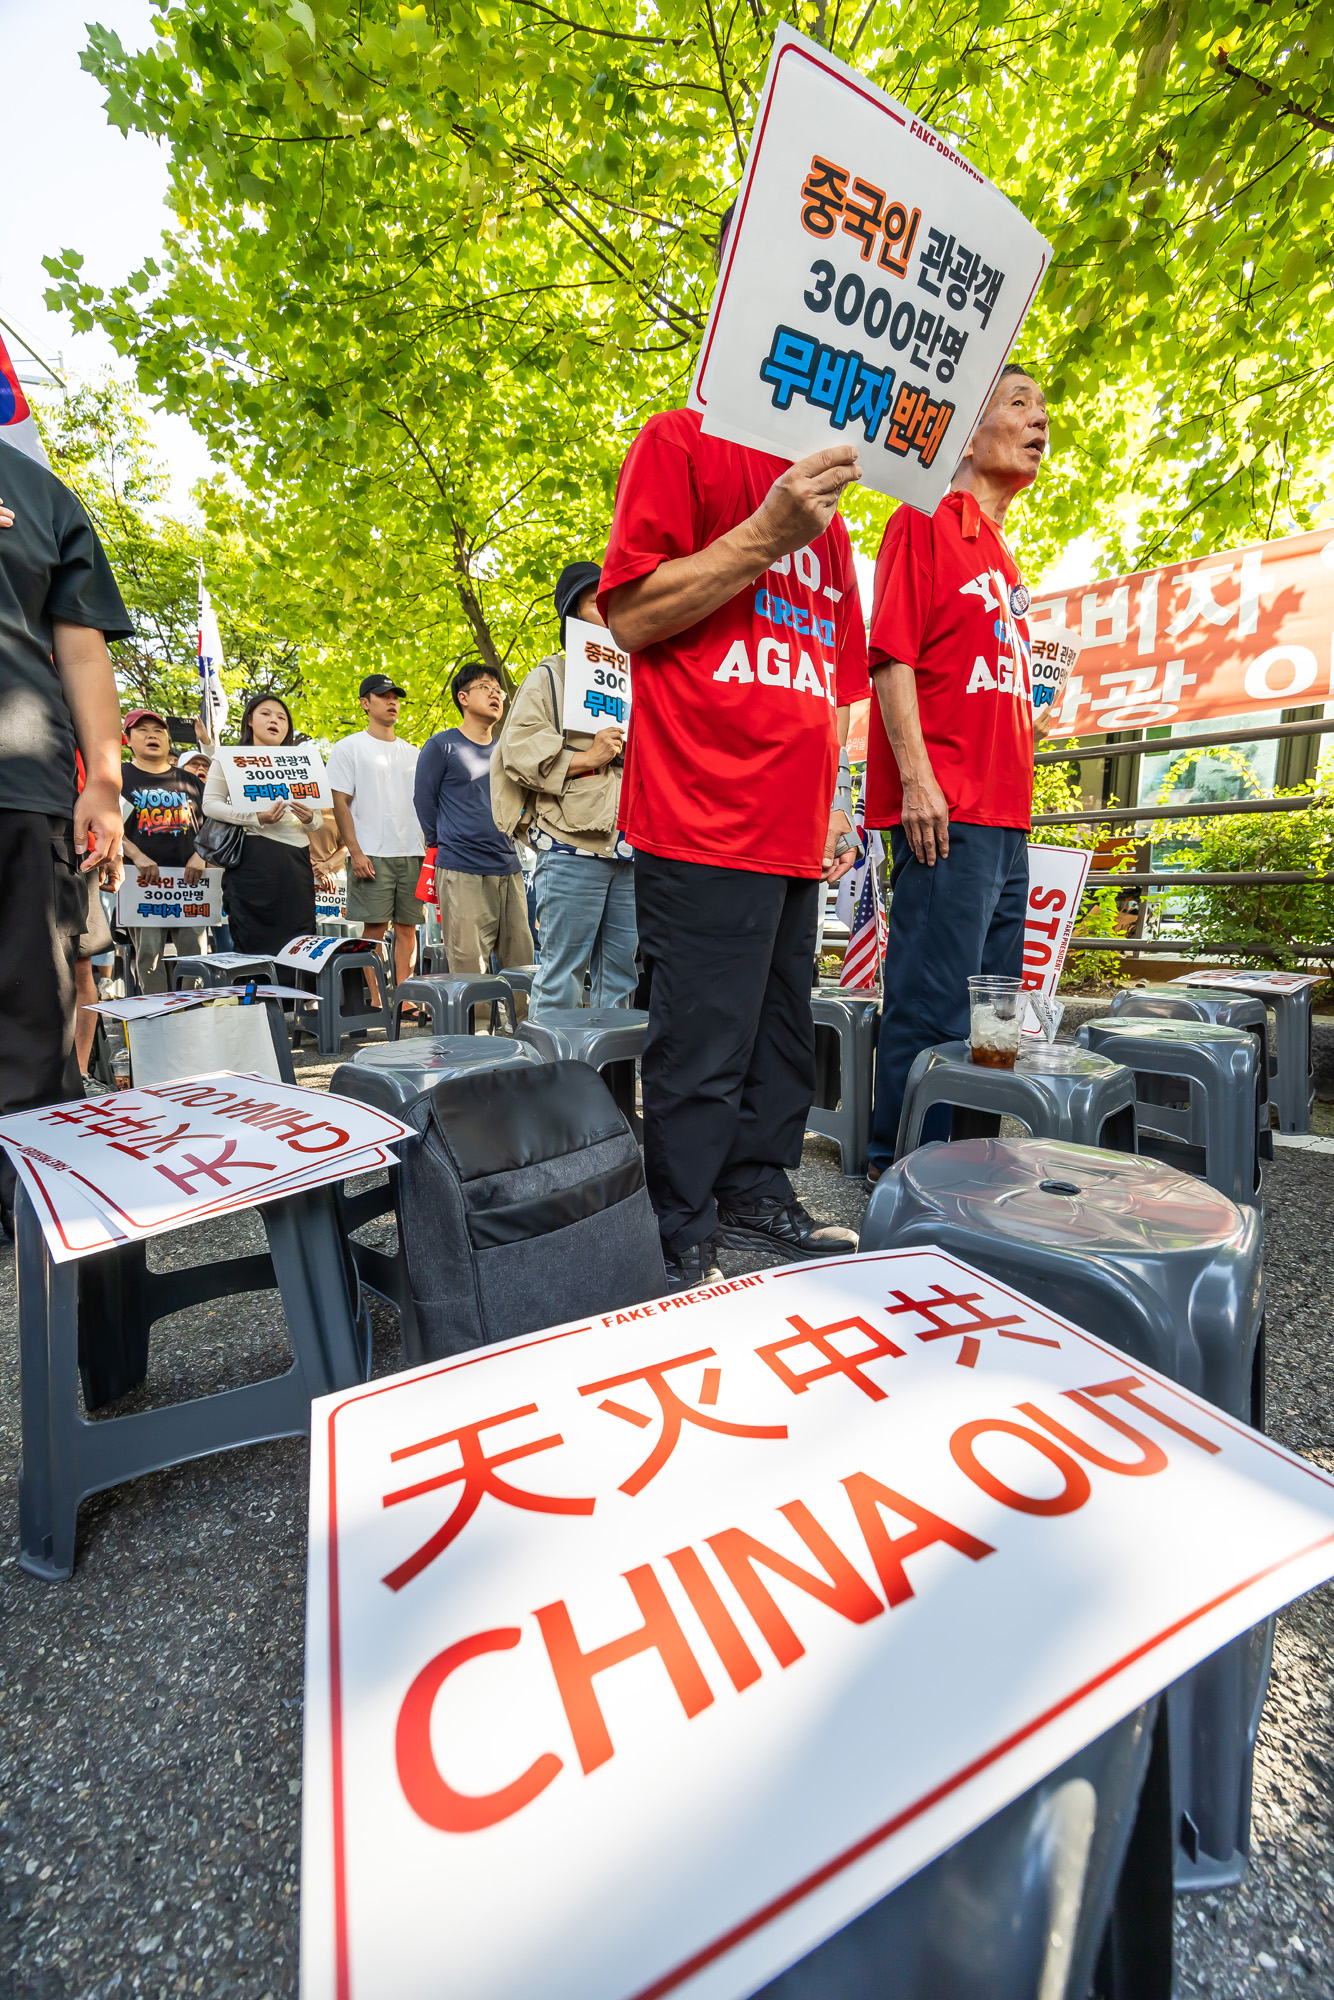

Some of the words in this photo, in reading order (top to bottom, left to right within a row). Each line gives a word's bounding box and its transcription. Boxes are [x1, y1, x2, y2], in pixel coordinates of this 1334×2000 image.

[909, 119, 937, 147] FAKE
[800, 154, 921, 280] 중국인
[918, 226, 1006, 331] 관광객
[803, 259, 969, 383] 3000만명
[760, 325, 896, 444] 무비자
[884, 381, 956, 469] 반대
[754, 588, 836, 648] GREAT
[584, 640, 629, 676] 중국인
[1032, 639, 1060, 661] 국인
[593, 668, 627, 694] 300
[712, 637, 837, 708] AGAI
[965, 655, 1032, 702] AGA
[232, 755, 273, 768] 중국인
[273, 755, 311, 767] 관광객
[245, 768, 309, 781] 3000만명
[132, 788, 189, 808] YOON
[243, 783, 289, 801] 무비자
[290, 782, 321, 800] 반대
[138, 807, 192, 829] AGAIN
[137, 903, 182, 918] 무비자
[183, 903, 210, 917] 반대
[144, 890, 204, 901] 3000만명
[1062, 920, 1073, 938] FAKE
[1054, 937, 1068, 972] PRESIDENT
[140, 1082, 239, 1108] OUT
[211, 1097, 351, 1154] CHINA
[37, 1097, 278, 1196] 天灭中共
[601, 1305, 658, 1328] FAKE
[658, 1274, 765, 1313] PRESIDENT
[381, 1283, 1062, 1594] 天灭中共
[394, 1470, 997, 1834] CHINA
[949, 1375, 1223, 1517] OUT
